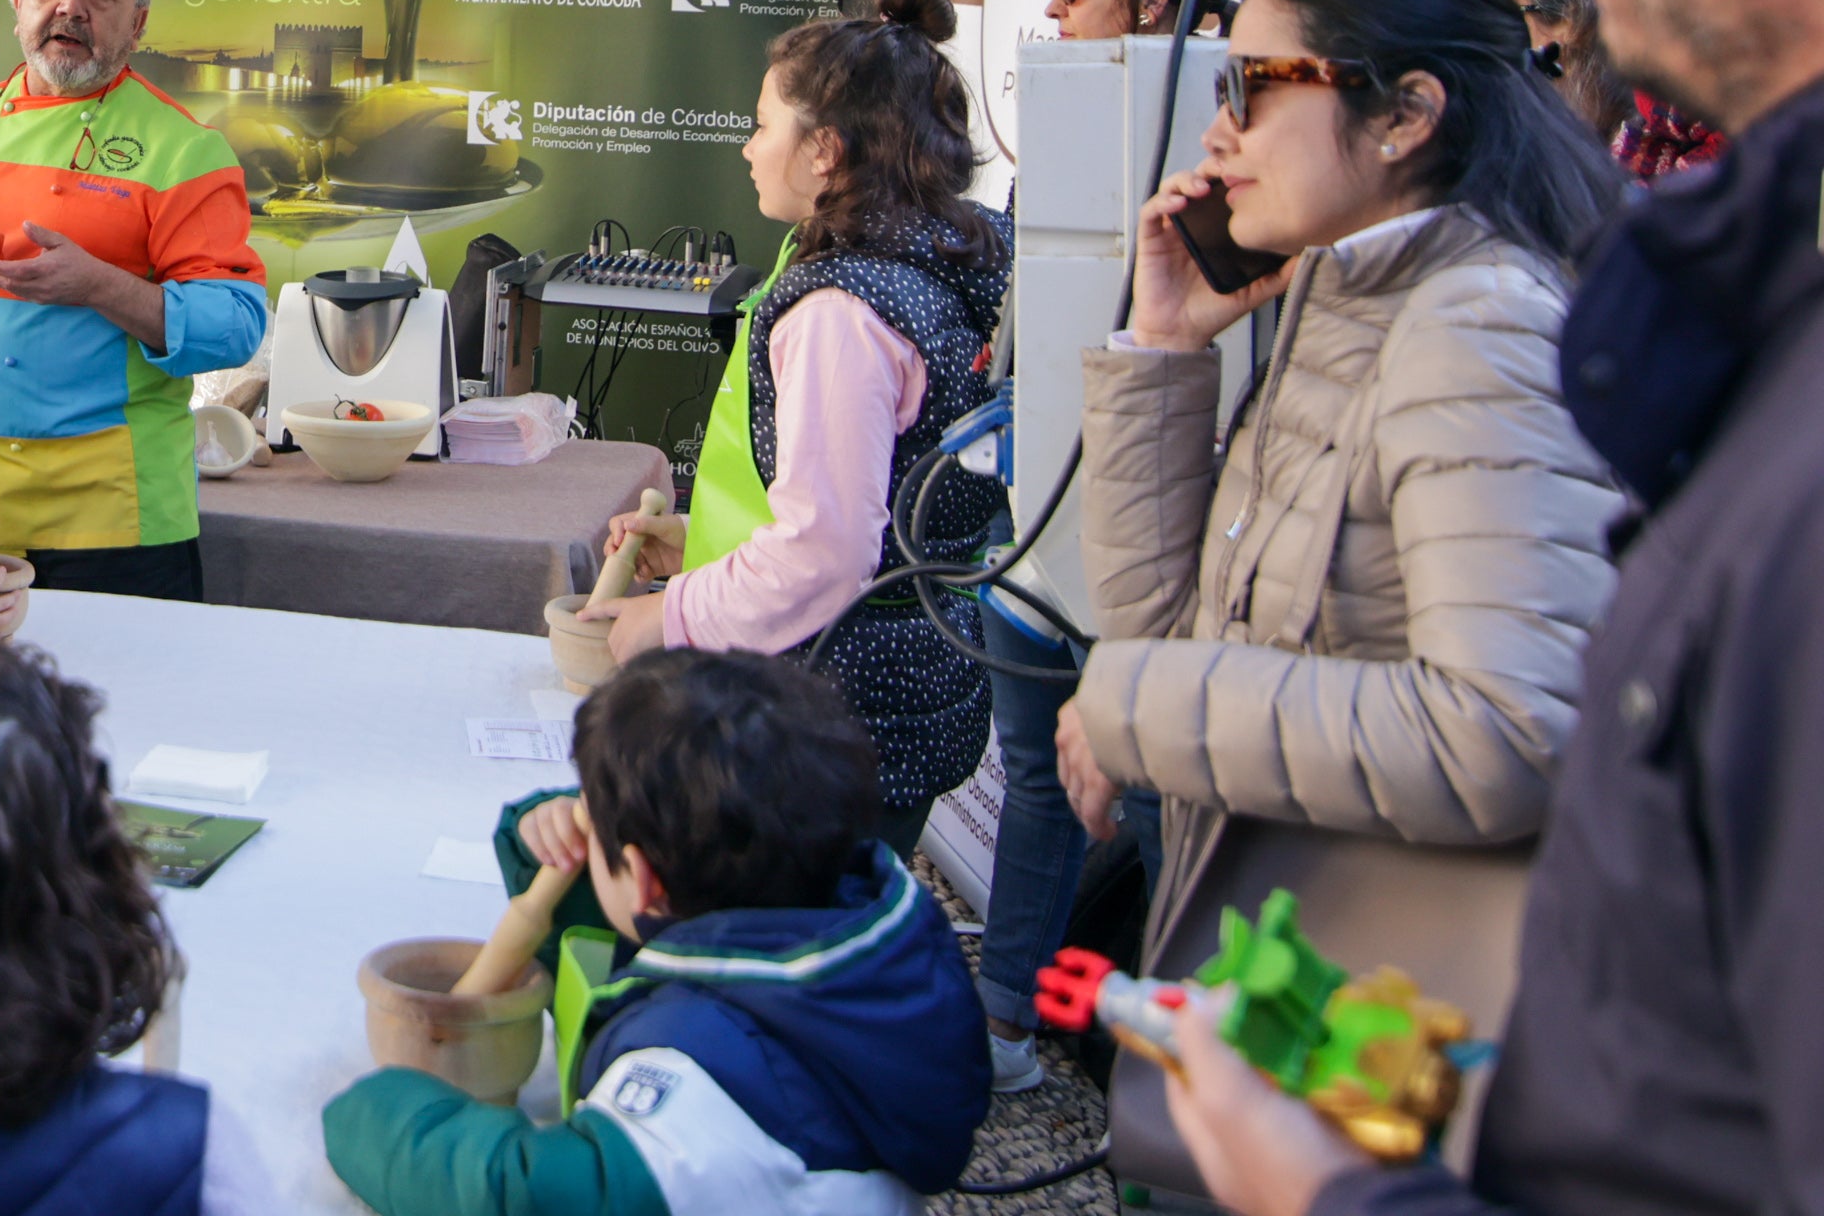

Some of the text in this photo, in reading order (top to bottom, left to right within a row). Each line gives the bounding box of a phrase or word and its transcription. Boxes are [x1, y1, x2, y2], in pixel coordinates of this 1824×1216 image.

[740, 3, 805, 17] Promoción
[807, 8, 816, 19] y
[533, 101, 752, 129] Diputación de Córdoba
[532, 123, 598, 137] Delegación
[601, 126, 616, 137] de
[620, 127, 680, 140] Desarrollo
[532, 137, 651, 155] Promoción y Empleo
[566, 332, 582, 344] DE
[658, 339, 678, 351] DEL
